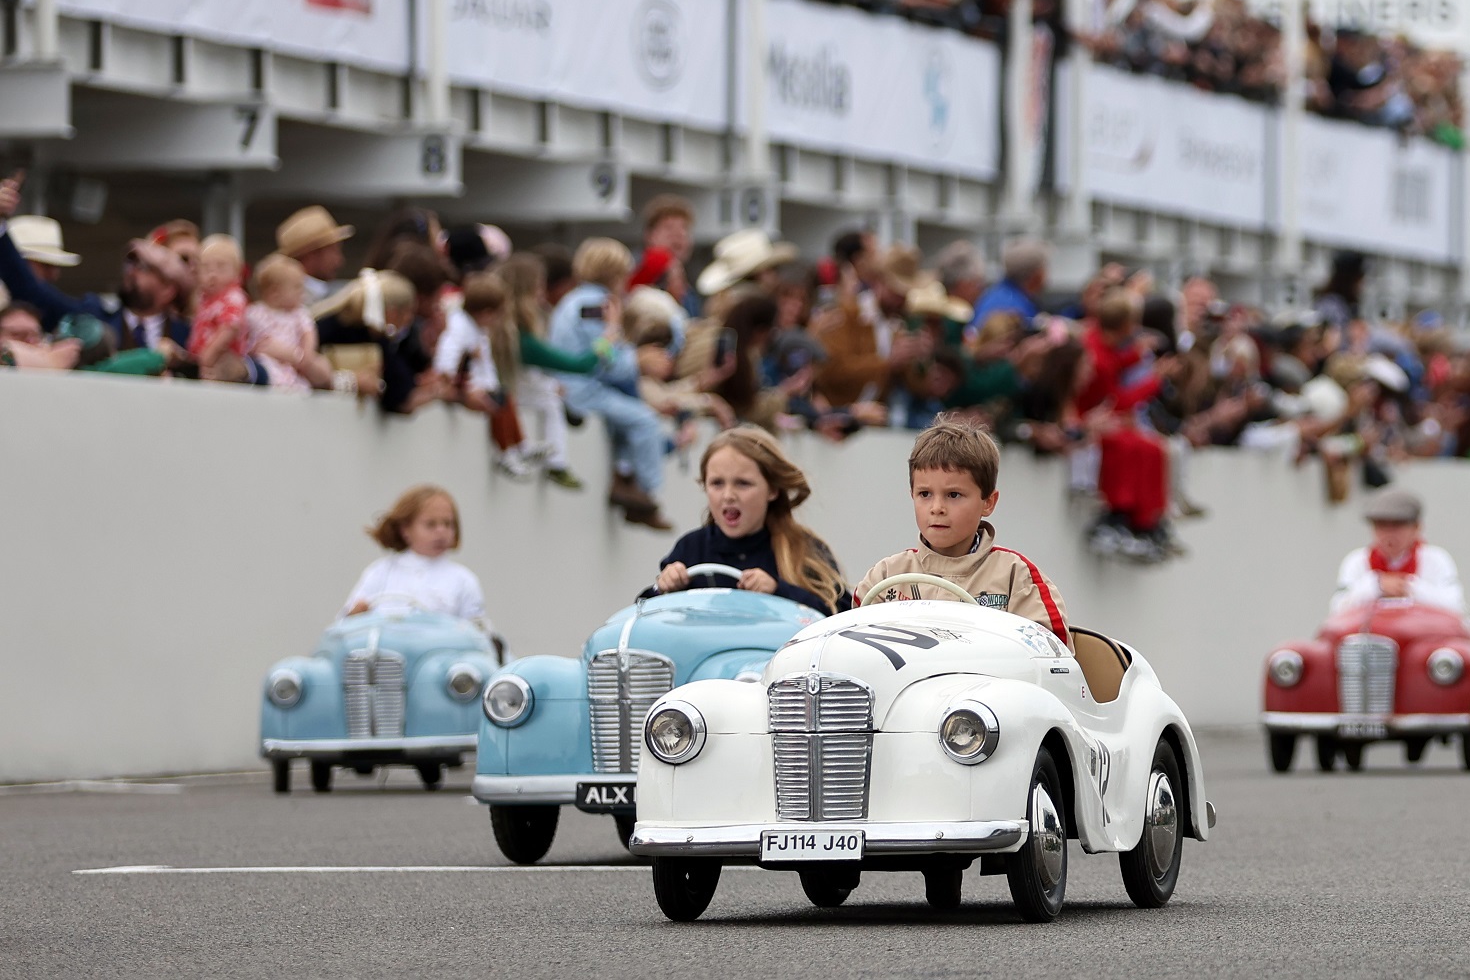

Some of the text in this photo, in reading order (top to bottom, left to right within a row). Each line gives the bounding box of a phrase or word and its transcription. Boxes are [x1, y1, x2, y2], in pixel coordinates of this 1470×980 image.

[234, 105, 259, 148] 7
[422, 134, 445, 175] 8
[591, 162, 617, 202] 9
[585, 786, 629, 805] ALX
[767, 834, 858, 851] FJ114 J40
